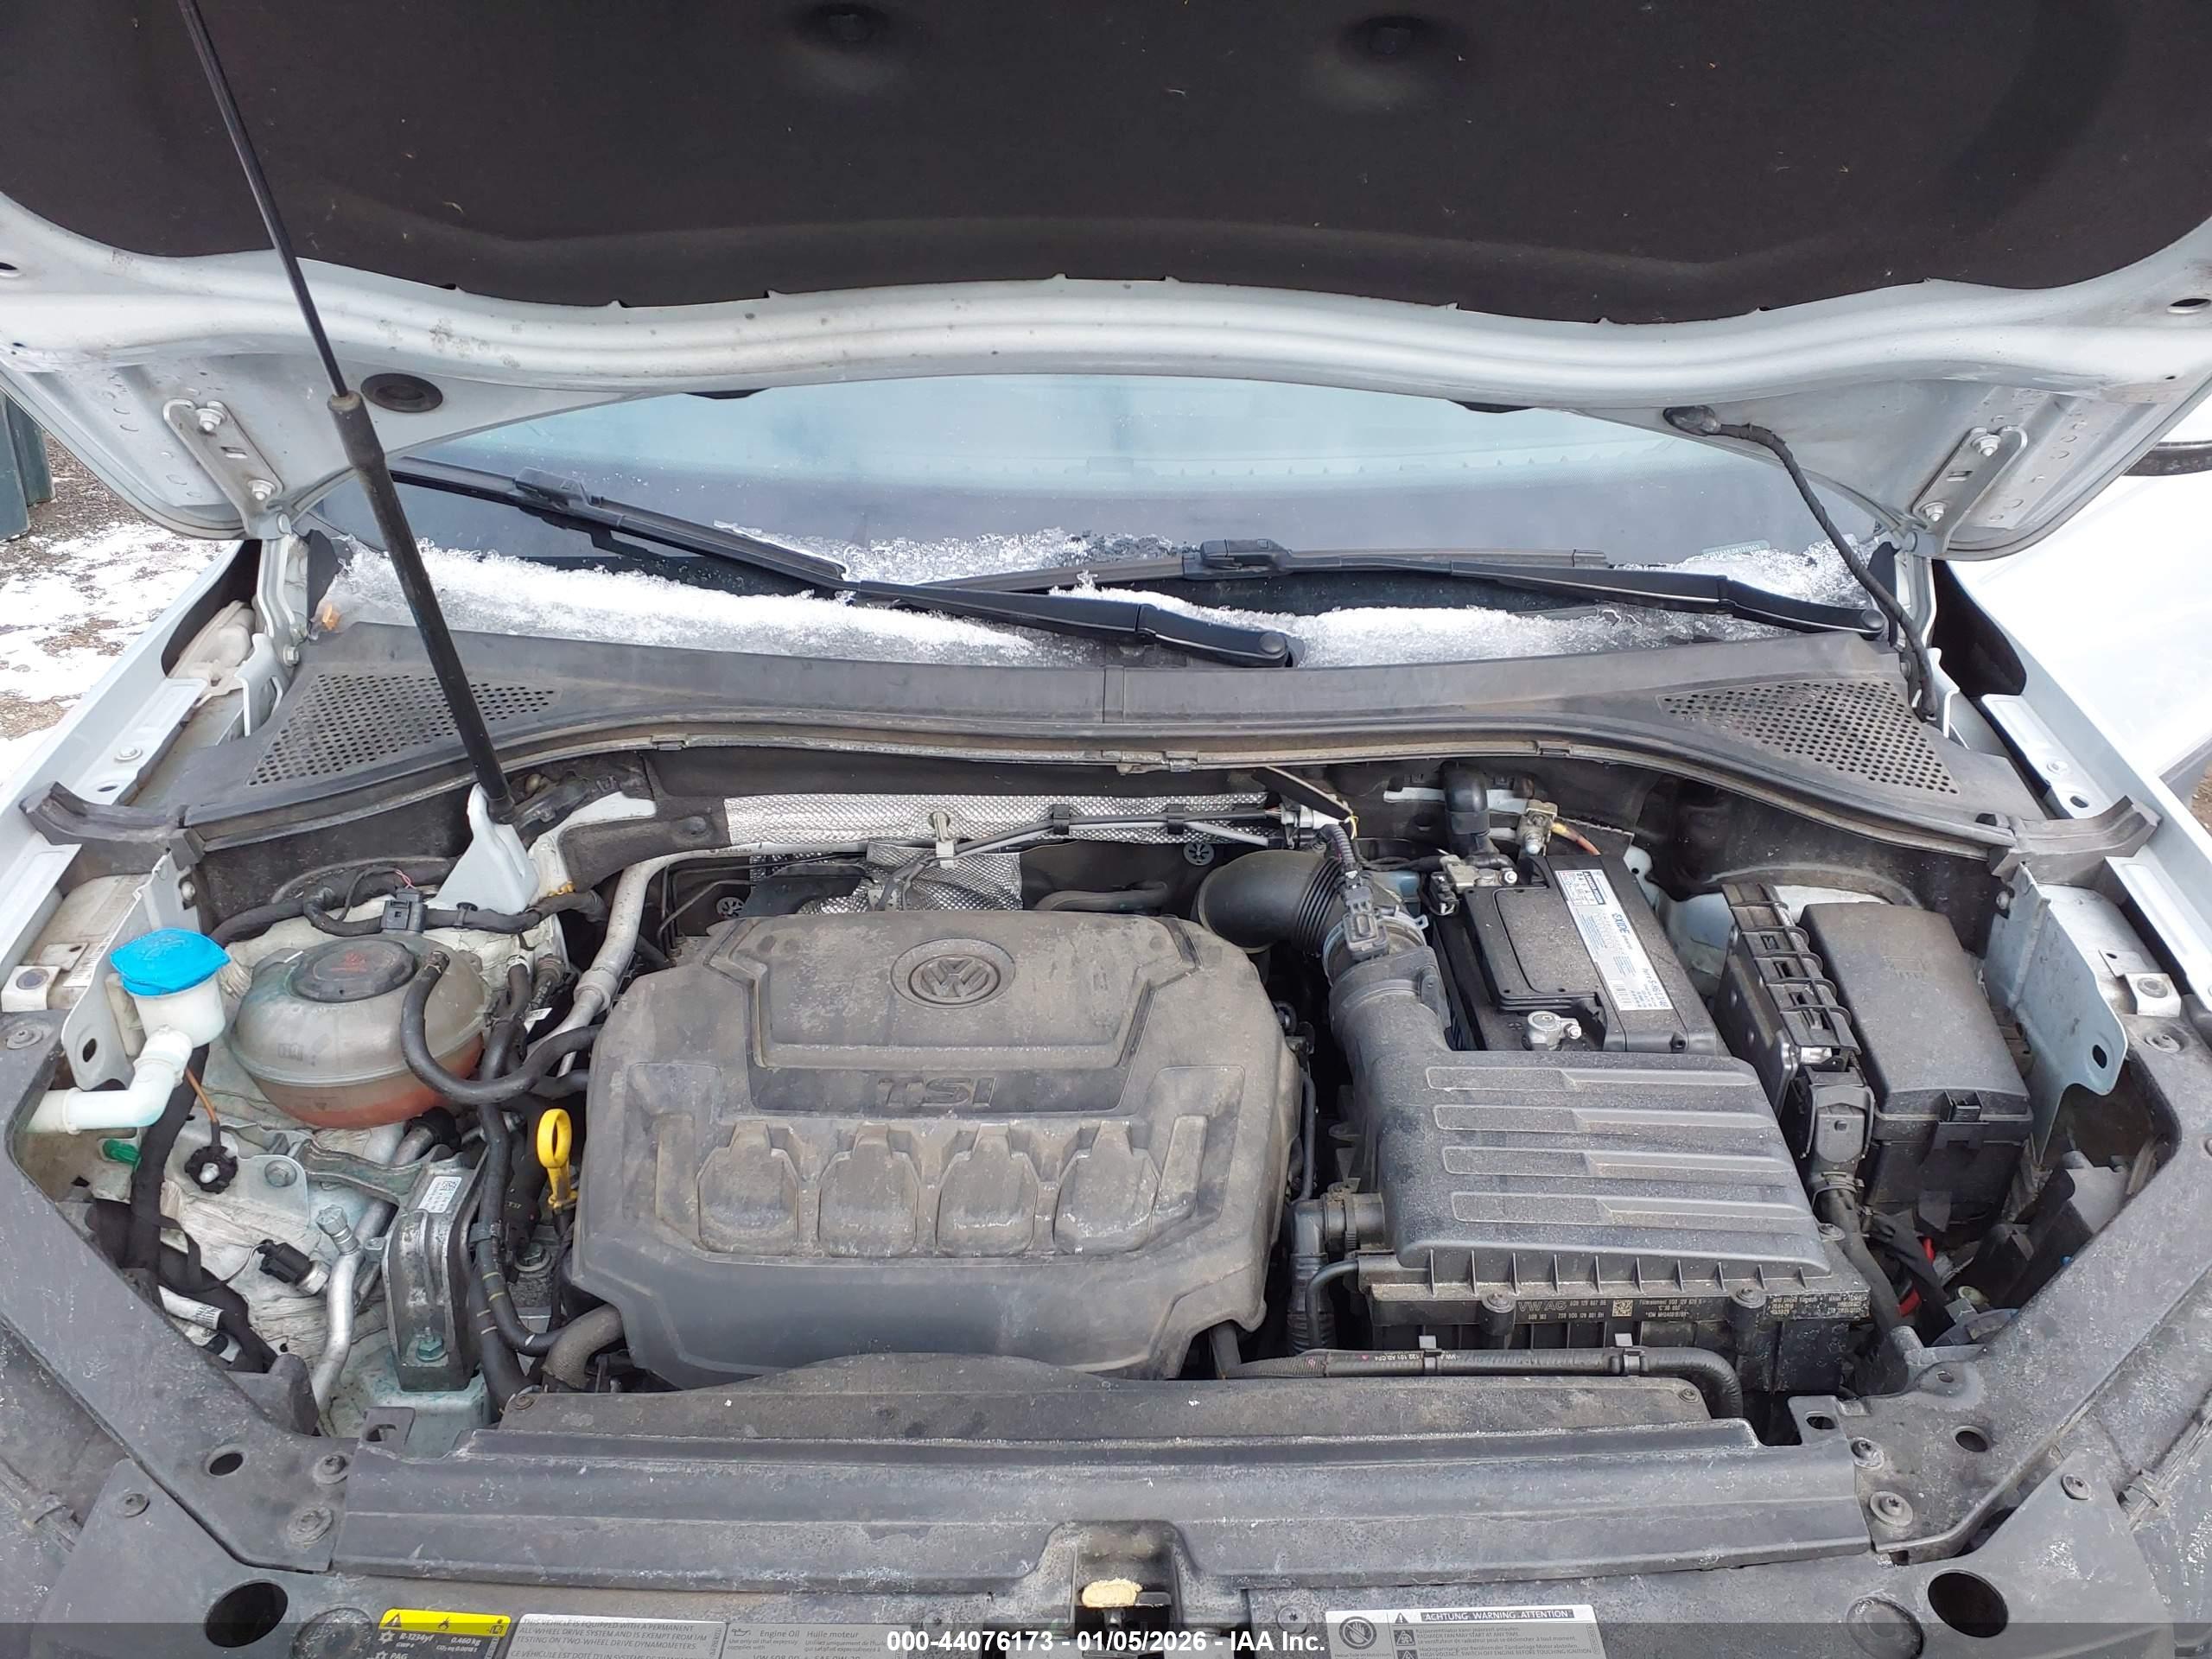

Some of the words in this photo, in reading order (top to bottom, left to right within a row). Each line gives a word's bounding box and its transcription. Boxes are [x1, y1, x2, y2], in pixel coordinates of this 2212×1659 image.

[1611, 912, 1630, 934] EXIDE
[878, 1077, 996, 1107] TSI
[1518, 1301, 1542, 1312] VW
[1544, 1300, 1567, 1311] AG
[1426, 1612, 1469, 1621] ACHTUNG
[1472, 1611, 1516, 1620] WARNING
[1520, 1610, 1568, 1618] ATTENTION
[519, 1627, 561, 1636] ALL-WHEEL
[649, 1624, 694, 1632] PERMANENT
[398, 1632, 434, 1644] R-1234yf
[760, 1630, 787, 1639] Engine
[788, 1630, 800, 1638] Oil
[807, 1630, 828, 1639] Huile
[471, 1637, 481, 1647] kg
[518, 1636, 548, 1644] TESTING
[563, 1637, 610, 1646] TWO-WHEEL
[610, 1639, 634, 1648] DRIVE
[635, 1641, 698, 1650] DYNAMOMETERS.
